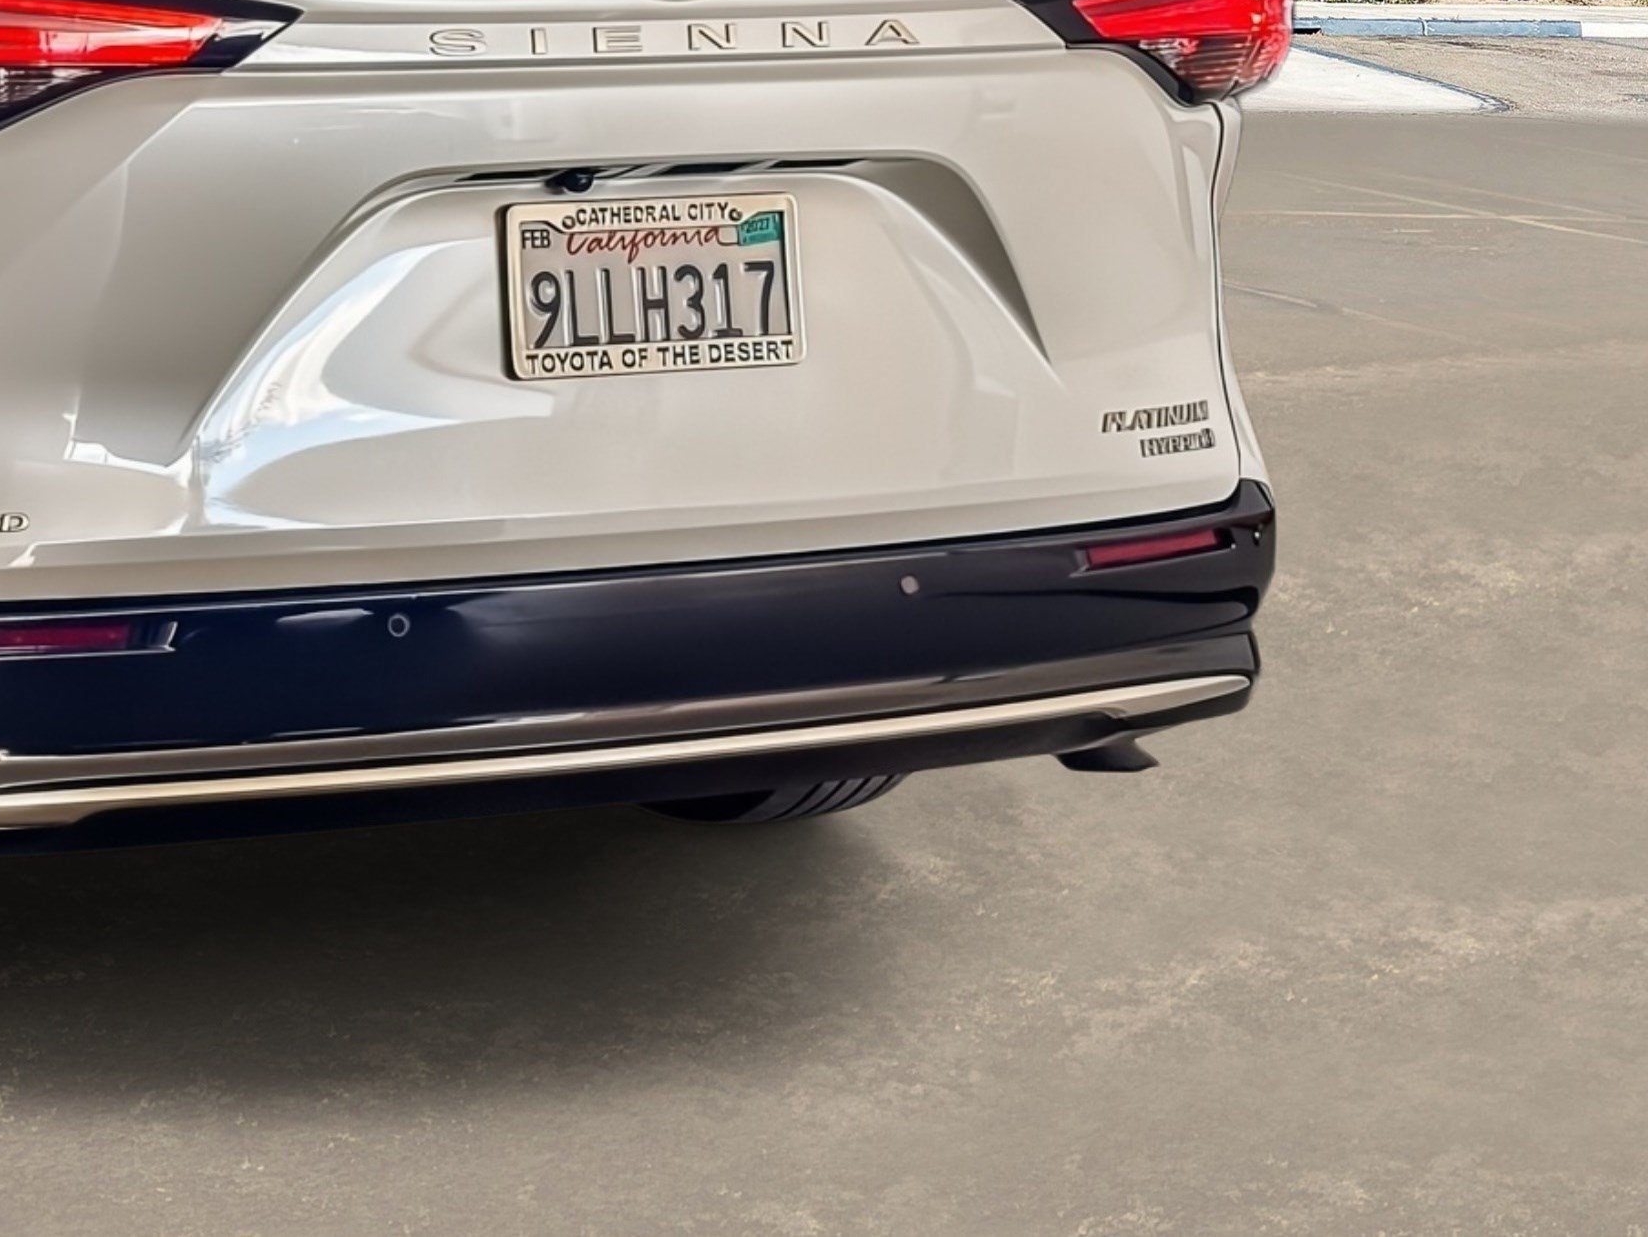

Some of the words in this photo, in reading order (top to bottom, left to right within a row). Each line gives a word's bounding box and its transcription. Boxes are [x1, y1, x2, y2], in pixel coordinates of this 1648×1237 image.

[428, 19, 920, 56] SIENNA
[576, 204, 681, 226] CATHEDRAL
[687, 202, 729, 221] CITY
[521, 229, 551, 249] FEB
[565, 226, 719, 264] California
[529, 260, 775, 349] 9LLH317
[526, 350, 613, 375] TOYOTA
[622, 348, 648, 369] OF
[657, 343, 701, 366] THE
[709, 340, 793, 364] DESERT
